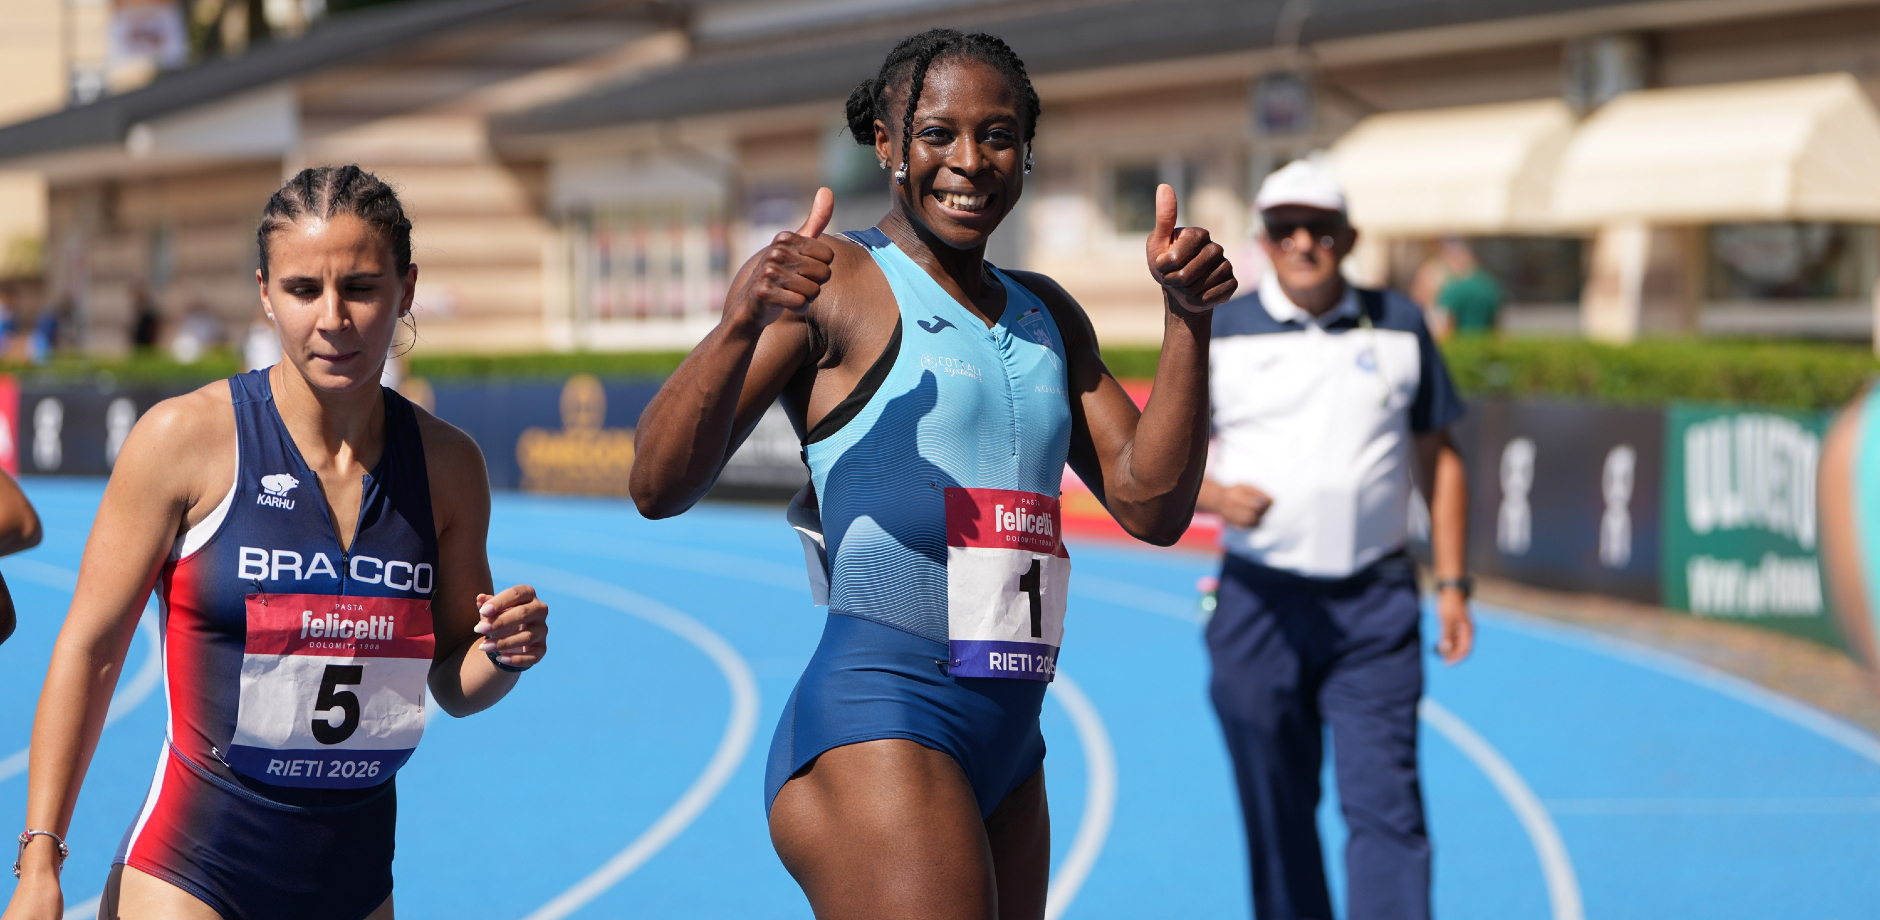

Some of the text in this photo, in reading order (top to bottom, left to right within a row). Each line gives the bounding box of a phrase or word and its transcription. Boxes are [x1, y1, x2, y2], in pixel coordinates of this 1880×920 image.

[256, 493, 296, 510] KARHU
[995, 504, 1054, 538] felicetti
[238, 546, 433, 594] BRACCO
[335, 603, 364, 611] PASTA
[1019, 558, 1042, 638] 1
[300, 610, 395, 641] felicetti
[309, 642, 356, 650] DOLOMITI
[989, 651, 1032, 672] RIETI
[311, 664, 364, 745] 5
[266, 758, 381, 779] RIETI 2026
